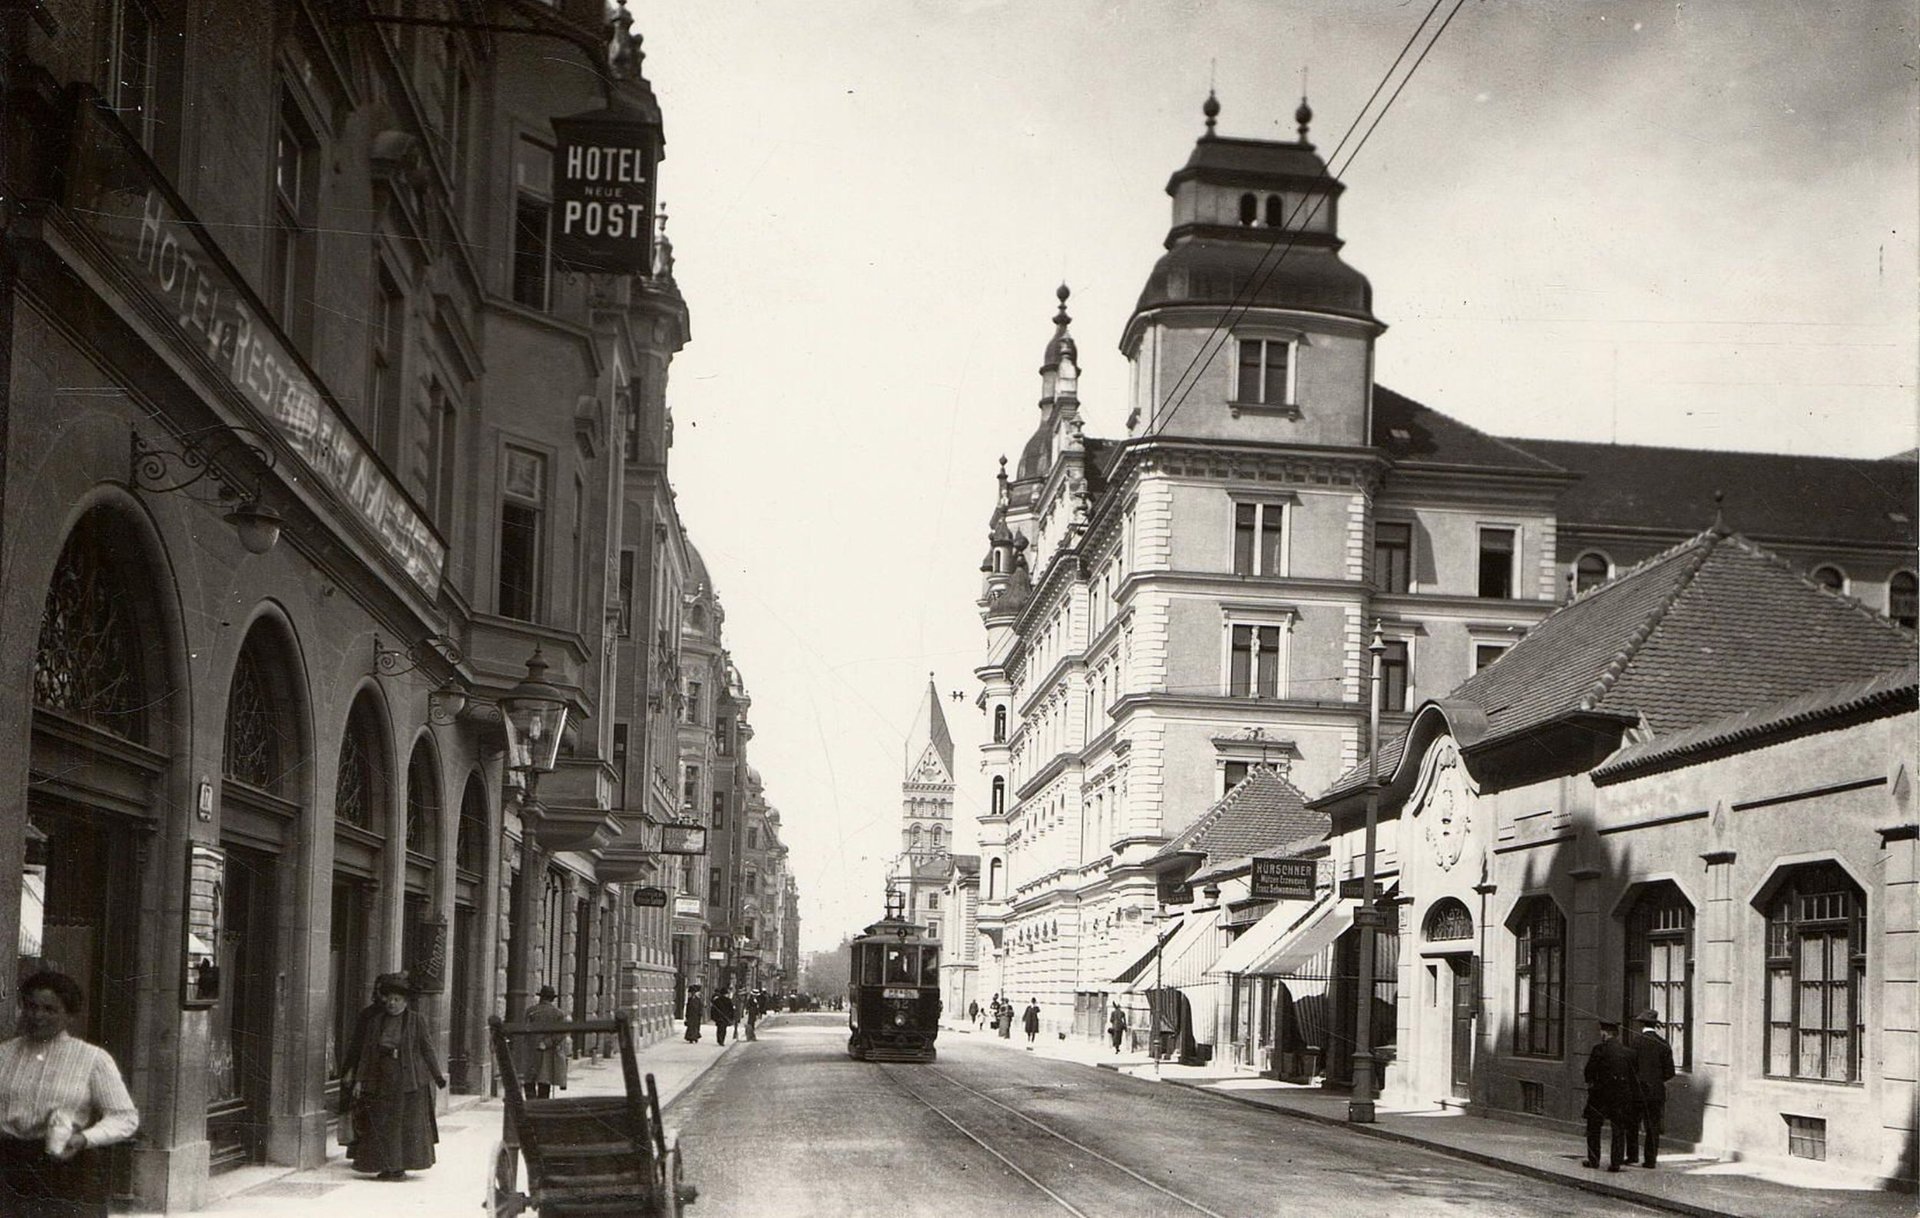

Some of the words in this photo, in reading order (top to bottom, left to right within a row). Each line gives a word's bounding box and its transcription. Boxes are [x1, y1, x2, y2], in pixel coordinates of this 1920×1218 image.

[567, 145, 646, 183] HOTEL
[584, 186, 623, 197] NEUE
[564, 201, 644, 238] POST
[138, 189, 222, 346] HOTEL
